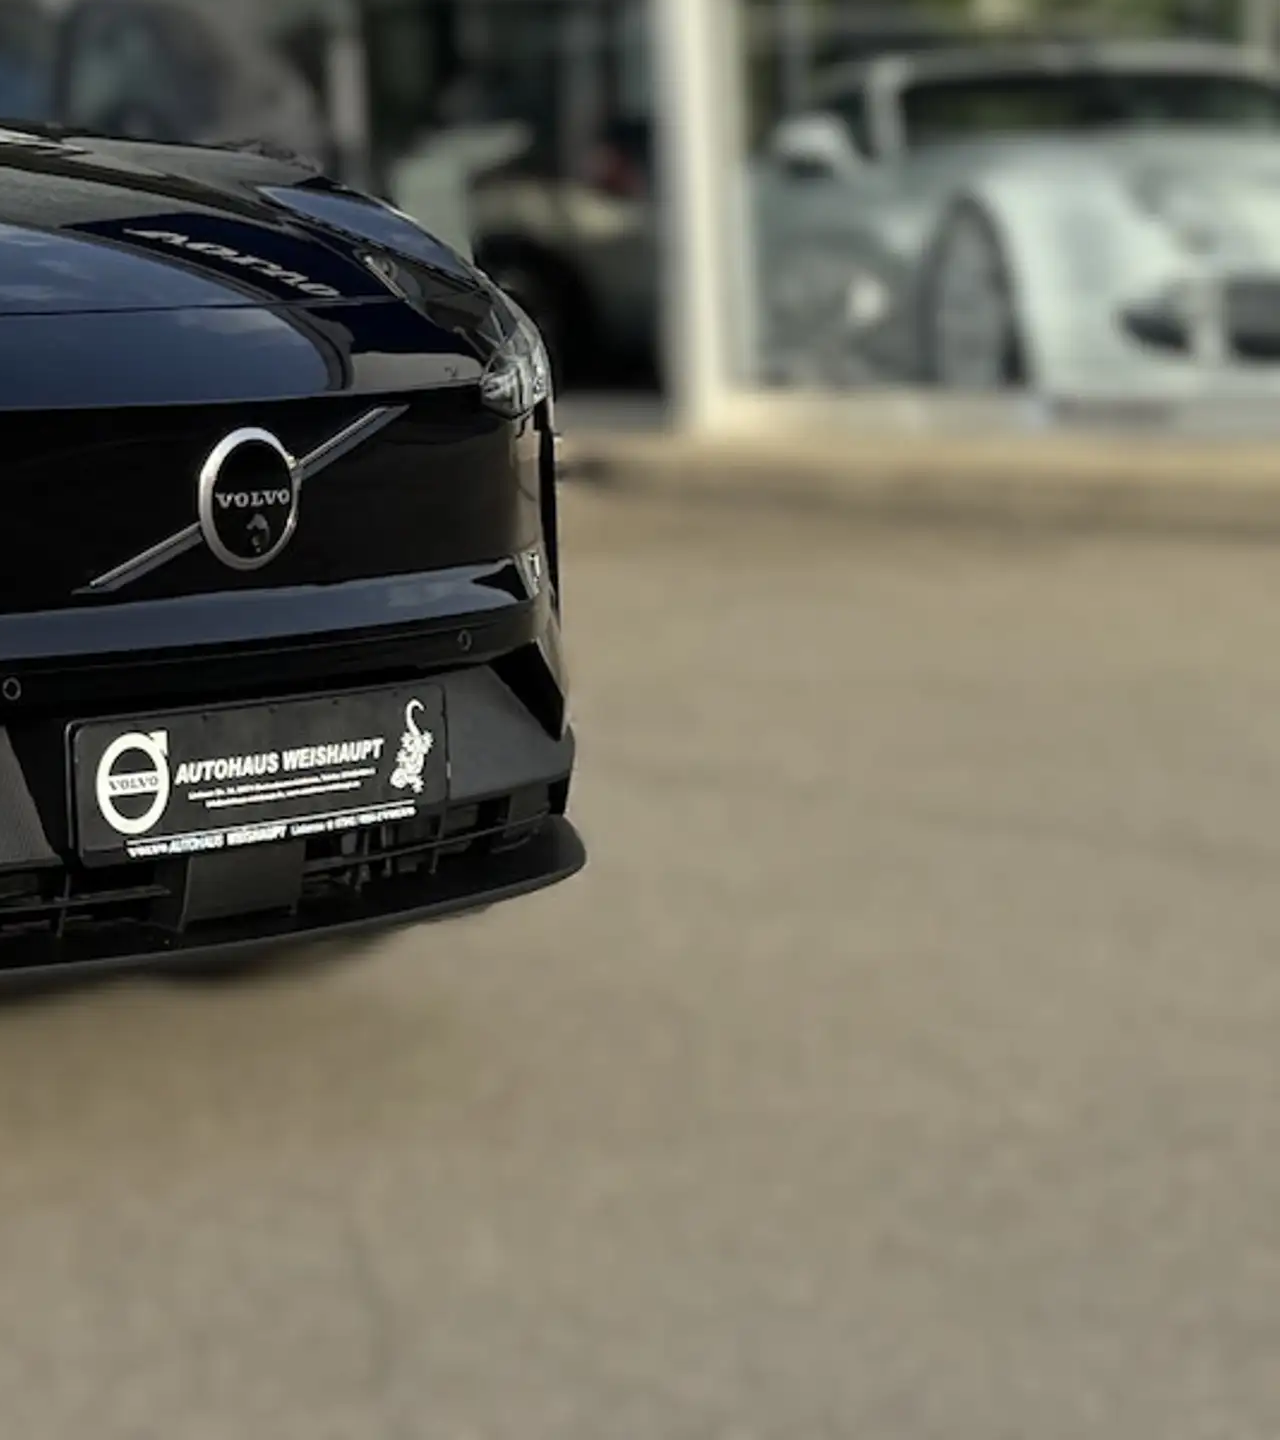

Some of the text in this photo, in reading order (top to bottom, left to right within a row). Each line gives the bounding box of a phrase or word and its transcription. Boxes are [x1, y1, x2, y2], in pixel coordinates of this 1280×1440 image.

[215, 488, 290, 509] VOLVO
[174, 751, 280, 785] AUTOHAUS
[282, 737, 385, 772] WEISHAUPT
[108, 775, 159, 791] VOLVO
